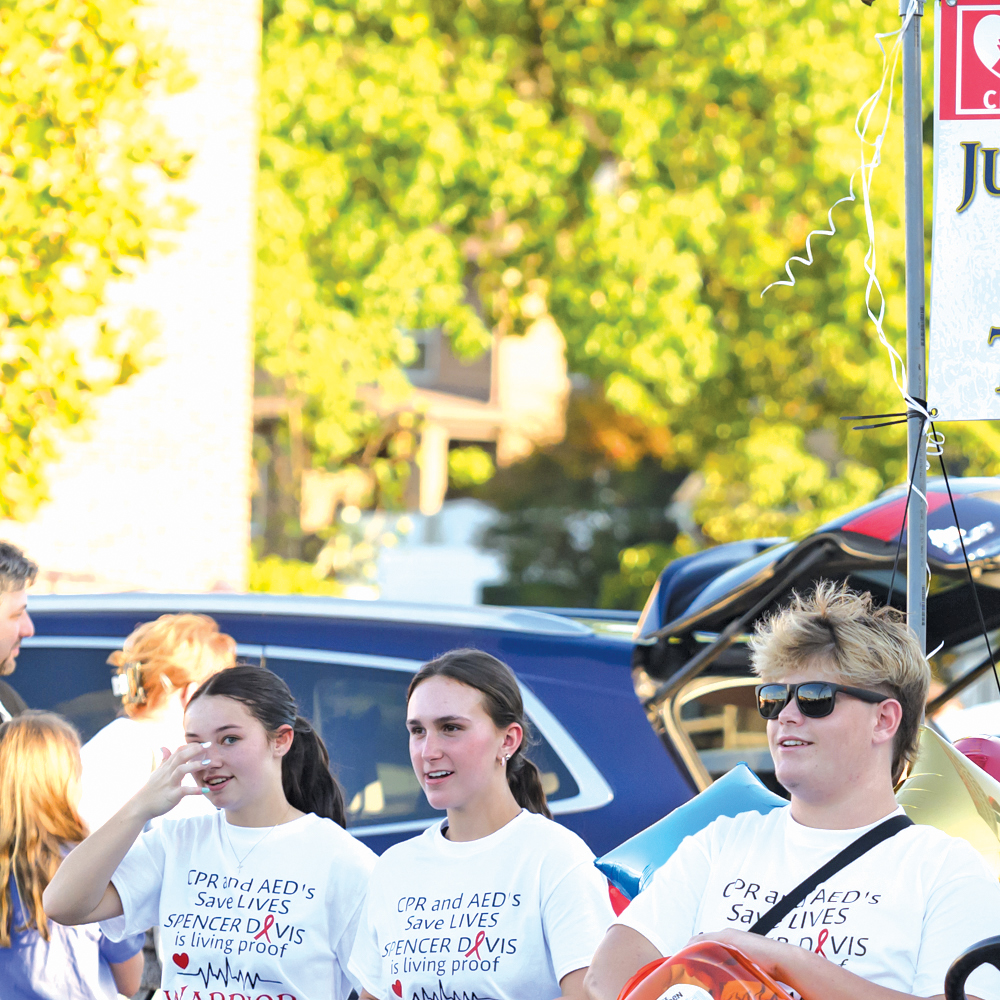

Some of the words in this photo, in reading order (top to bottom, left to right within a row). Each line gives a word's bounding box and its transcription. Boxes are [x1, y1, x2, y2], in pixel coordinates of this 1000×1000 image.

[187, 869, 219, 889] CPR
[222, 876, 254, 893] and
[257, 879, 316, 900] AED's
[810, 888, 882, 905] AED's
[194, 891, 234, 909] Save
[237, 894, 291, 915] LIVES
[397, 896, 427, 913] CPR
[431, 892, 464, 912] and
[467, 892, 521, 909] AED's
[404, 915, 444, 931] Save
[449, 912, 500, 930] LIVES
[726, 903, 780, 929] Sa
[788, 907, 850, 930] LIVES
[164, 913, 242, 933] SPENCER
[246, 915, 306, 945] DVIS
[175, 931, 186, 947] is
[190, 931, 234, 955] living
[238, 939, 289, 958] proof
[381, 937, 451, 958] SPENCER
[457, 933, 518, 957] DVIS
[390, 959, 399, 975] is
[403, 957, 447, 976] living
[451, 956, 501, 976] proof
